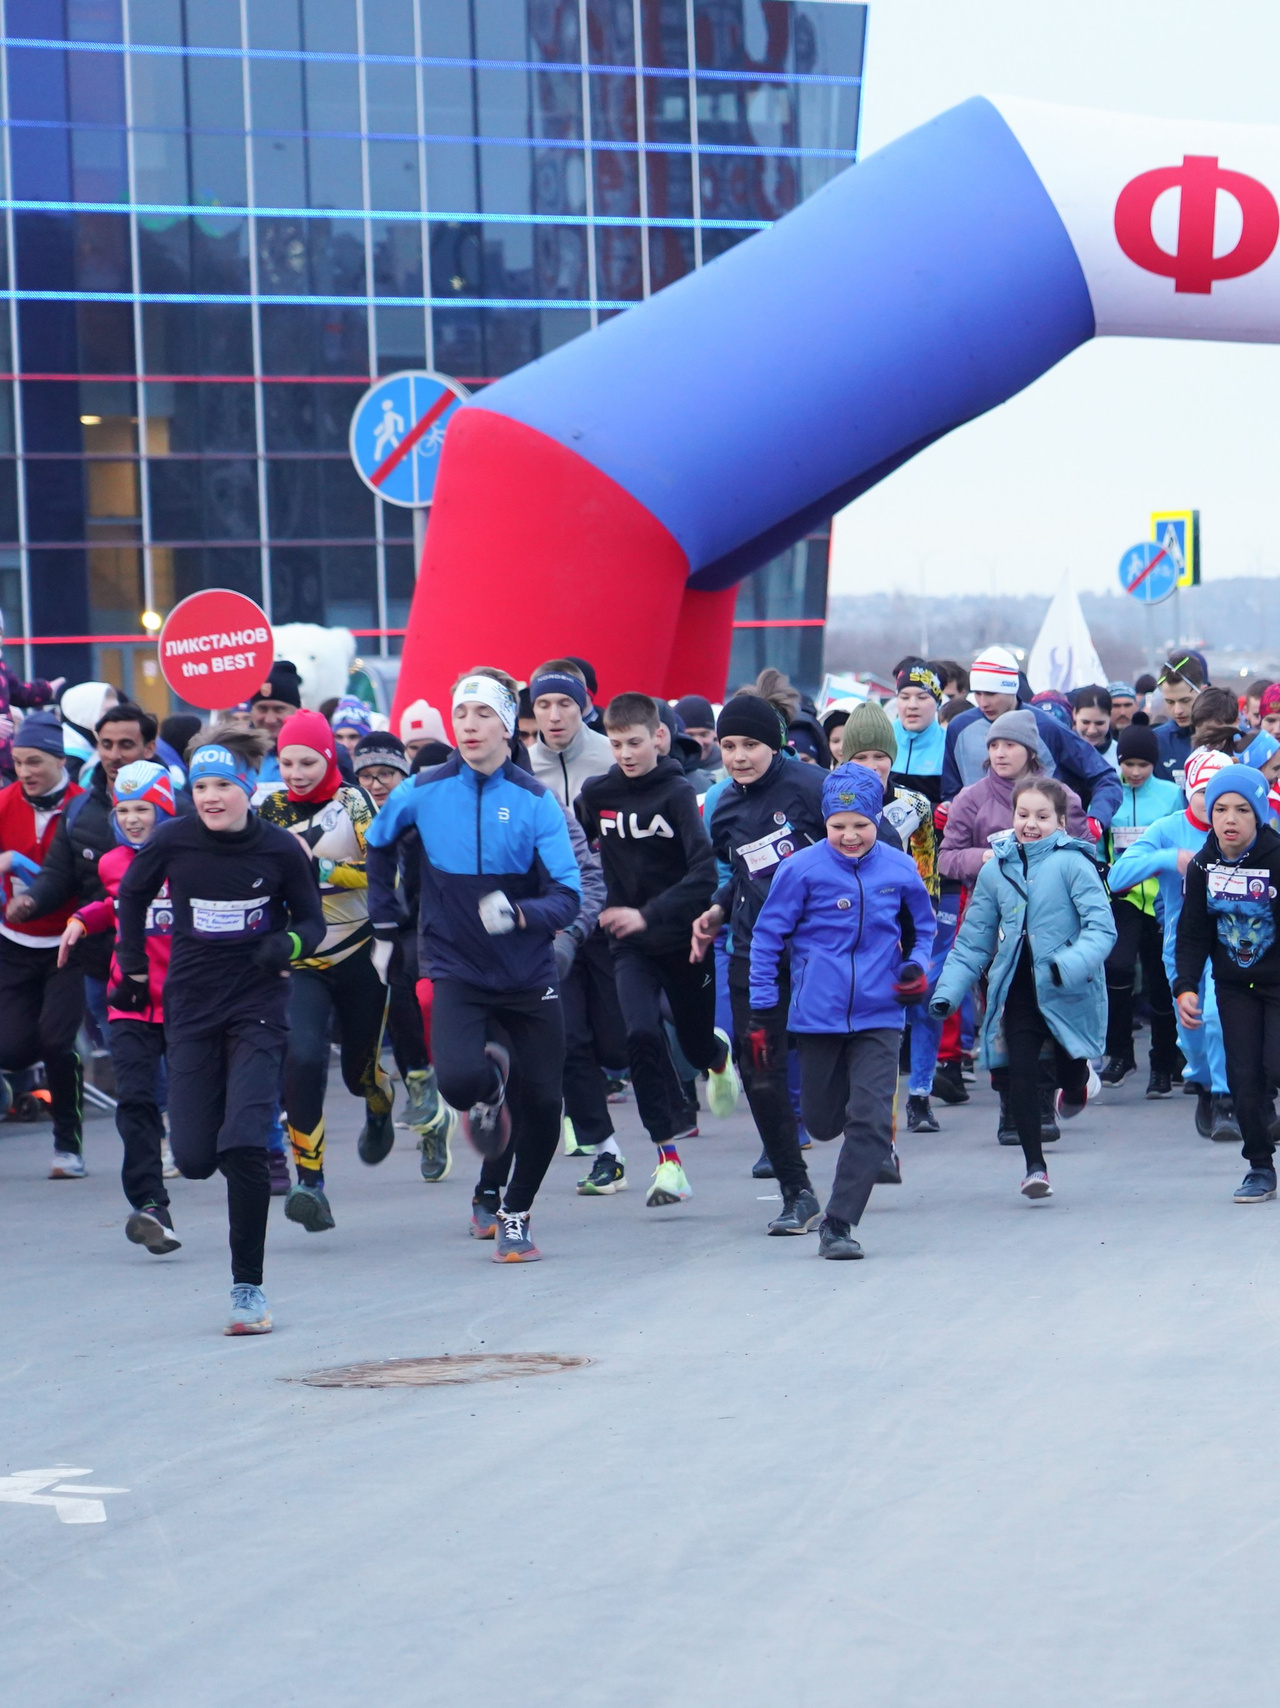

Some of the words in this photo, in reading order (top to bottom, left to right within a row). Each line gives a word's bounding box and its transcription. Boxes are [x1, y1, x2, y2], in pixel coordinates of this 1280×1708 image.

[165, 627, 268, 656] ЛИКСТАНОВ
[182, 661, 208, 677] the
[211, 652, 256, 673] BEST
[190, 750, 234, 767] KOIL
[599, 810, 674, 839] FILA
